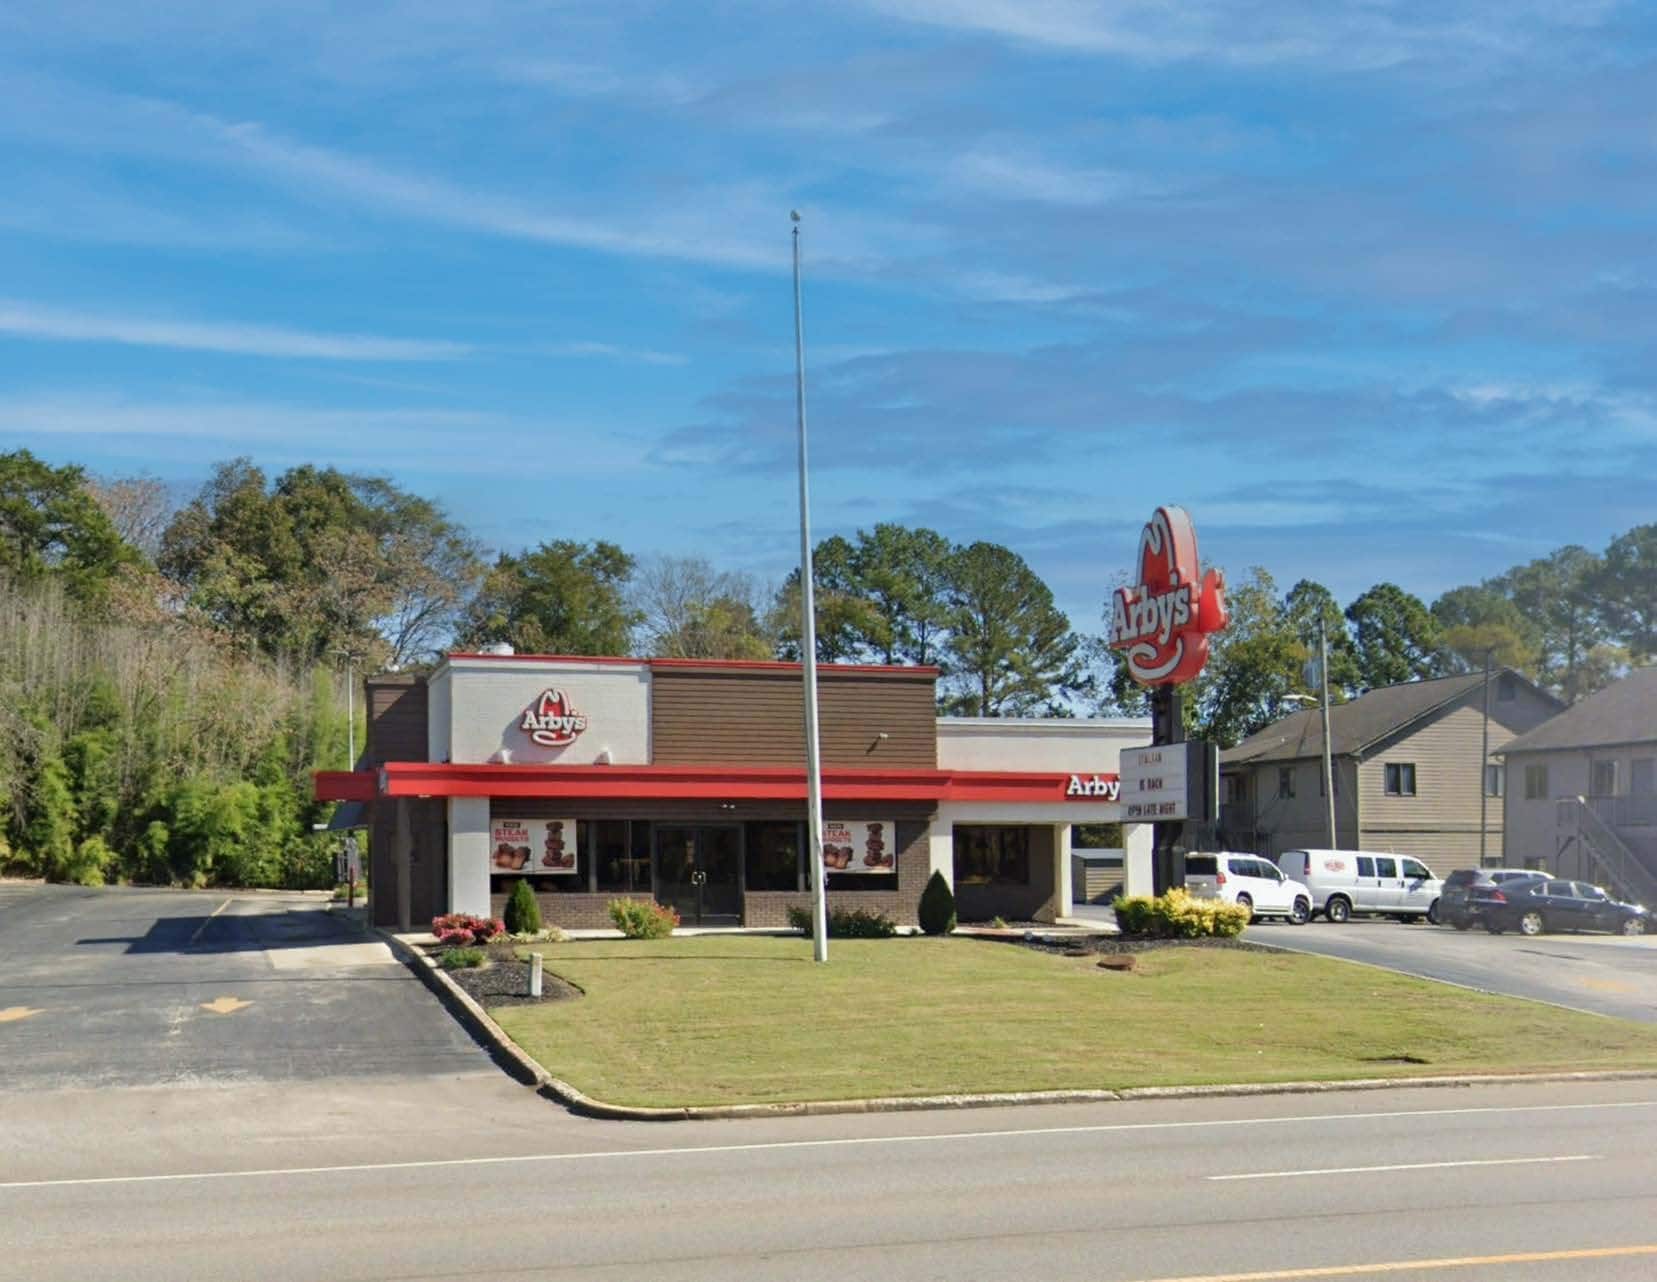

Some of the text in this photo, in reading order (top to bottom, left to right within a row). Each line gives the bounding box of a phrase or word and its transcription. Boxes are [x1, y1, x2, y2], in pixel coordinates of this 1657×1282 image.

[1109, 573, 1190, 645] Arby's
[521, 709, 586, 735] Arby's
[1147, 777, 1163, 790] BACK
[1143, 802, 1158, 816] LATE
[494, 828, 529, 837] STEAK
